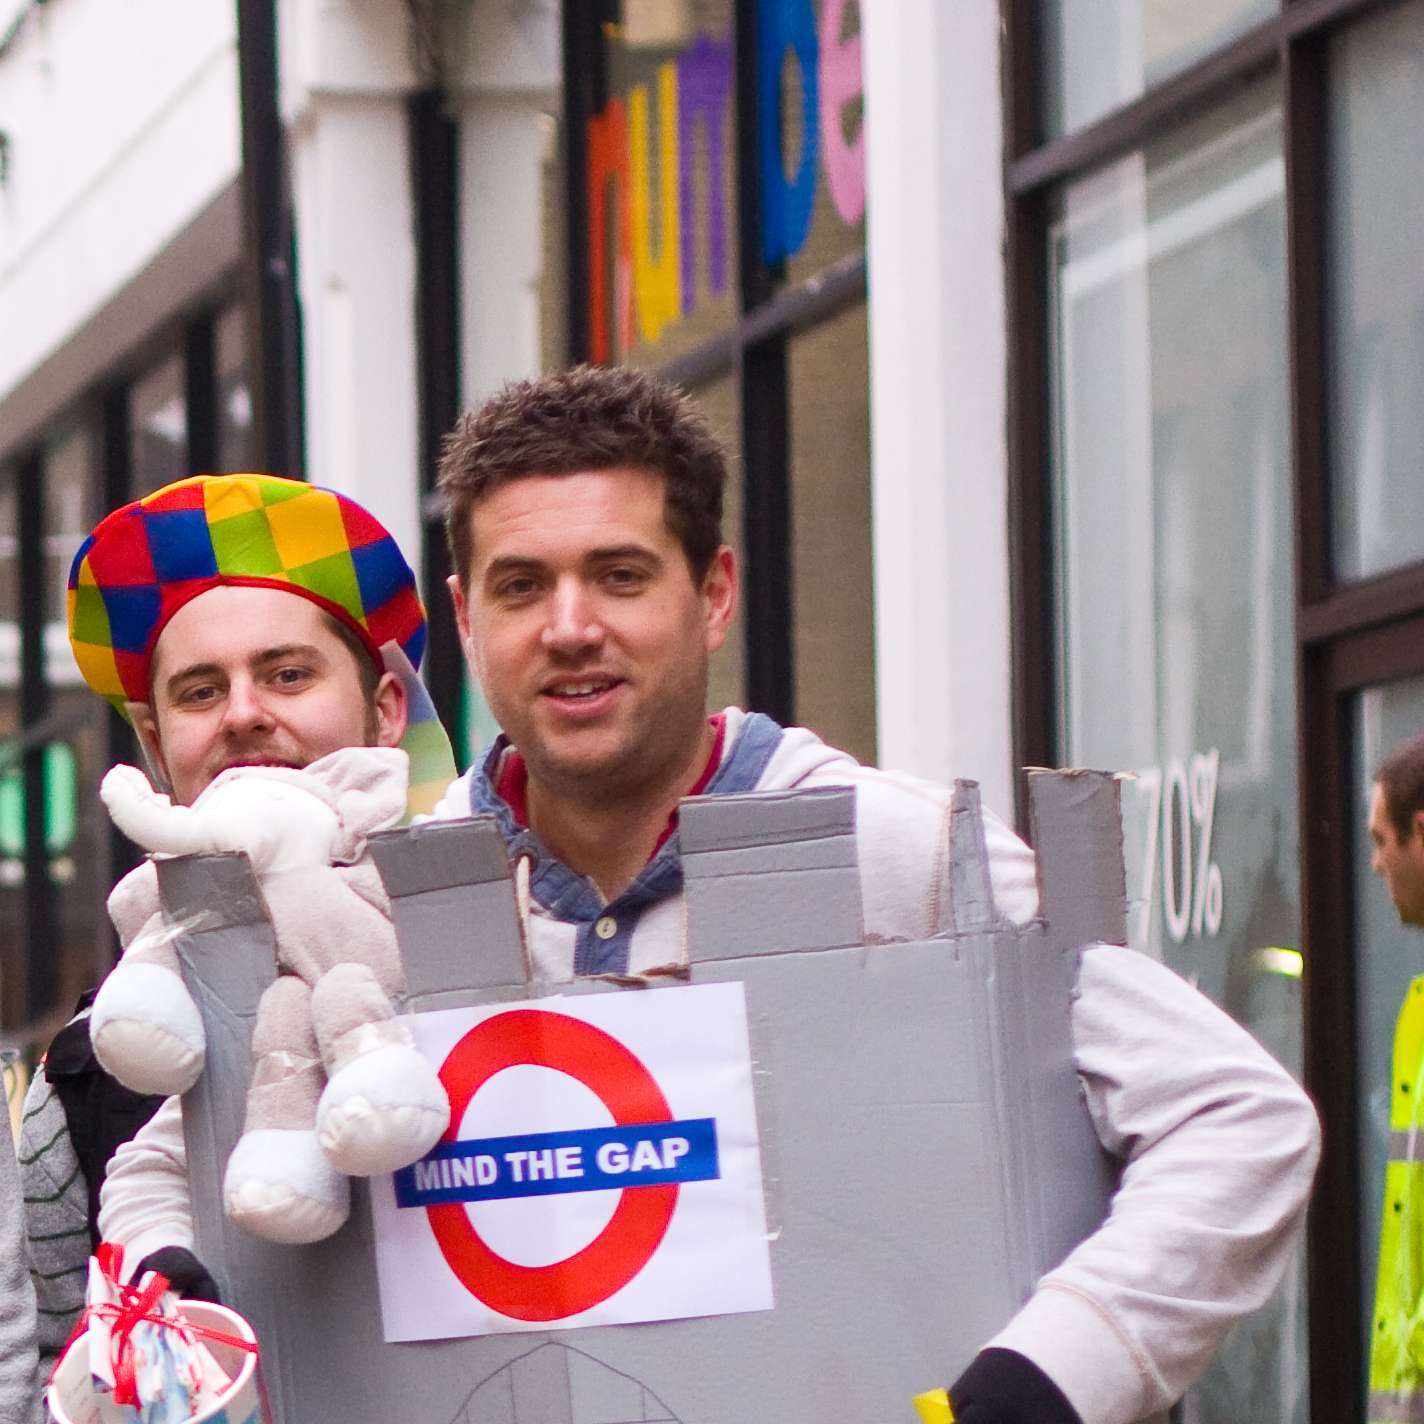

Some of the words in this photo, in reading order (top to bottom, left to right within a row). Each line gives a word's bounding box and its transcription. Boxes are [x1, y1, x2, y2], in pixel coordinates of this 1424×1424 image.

[414, 1155, 497, 1192] MIND
[504, 1146, 583, 1183] THE
[596, 1137, 690, 1174] GAP
